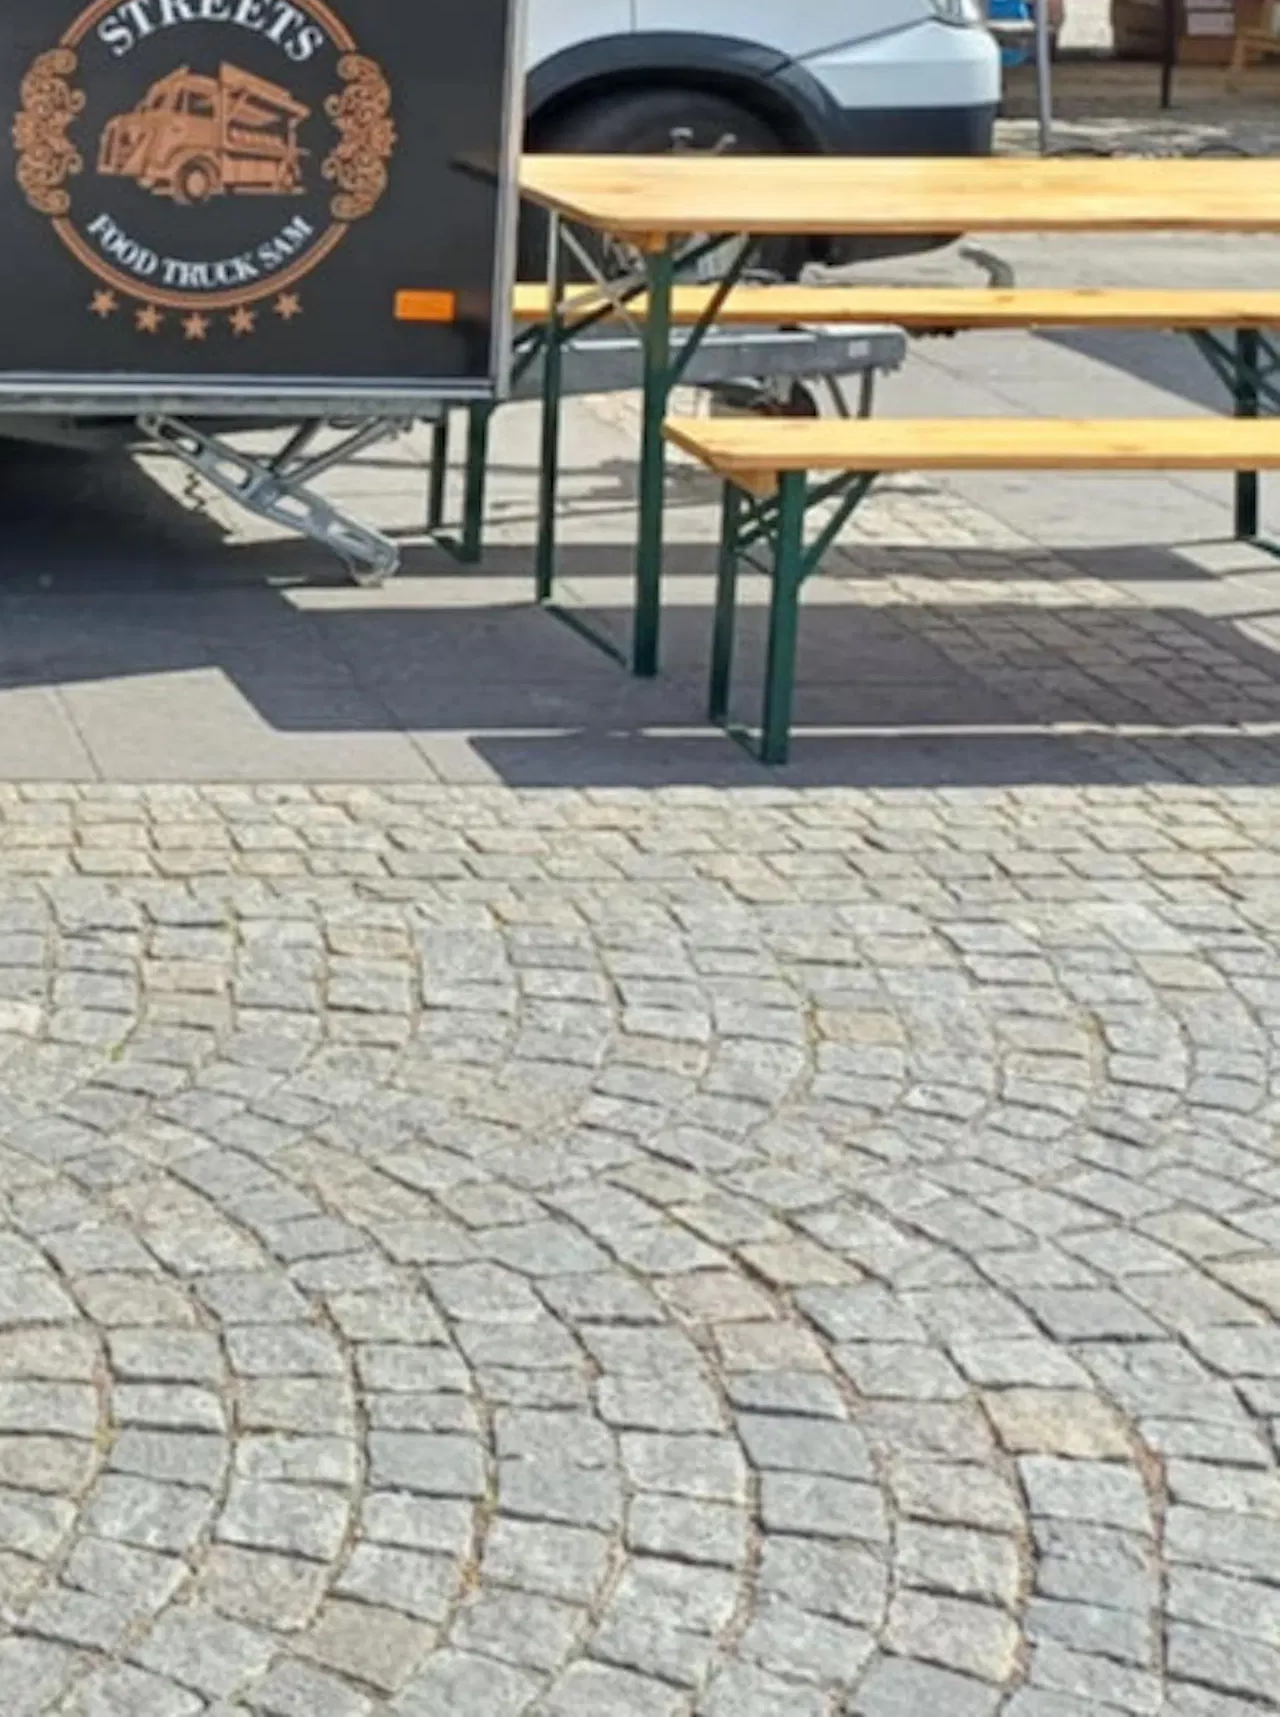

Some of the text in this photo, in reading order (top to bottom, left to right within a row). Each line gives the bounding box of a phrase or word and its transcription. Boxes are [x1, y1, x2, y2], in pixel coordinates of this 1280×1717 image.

[87, 213, 316, 288] FOOD TRUCK SAM
